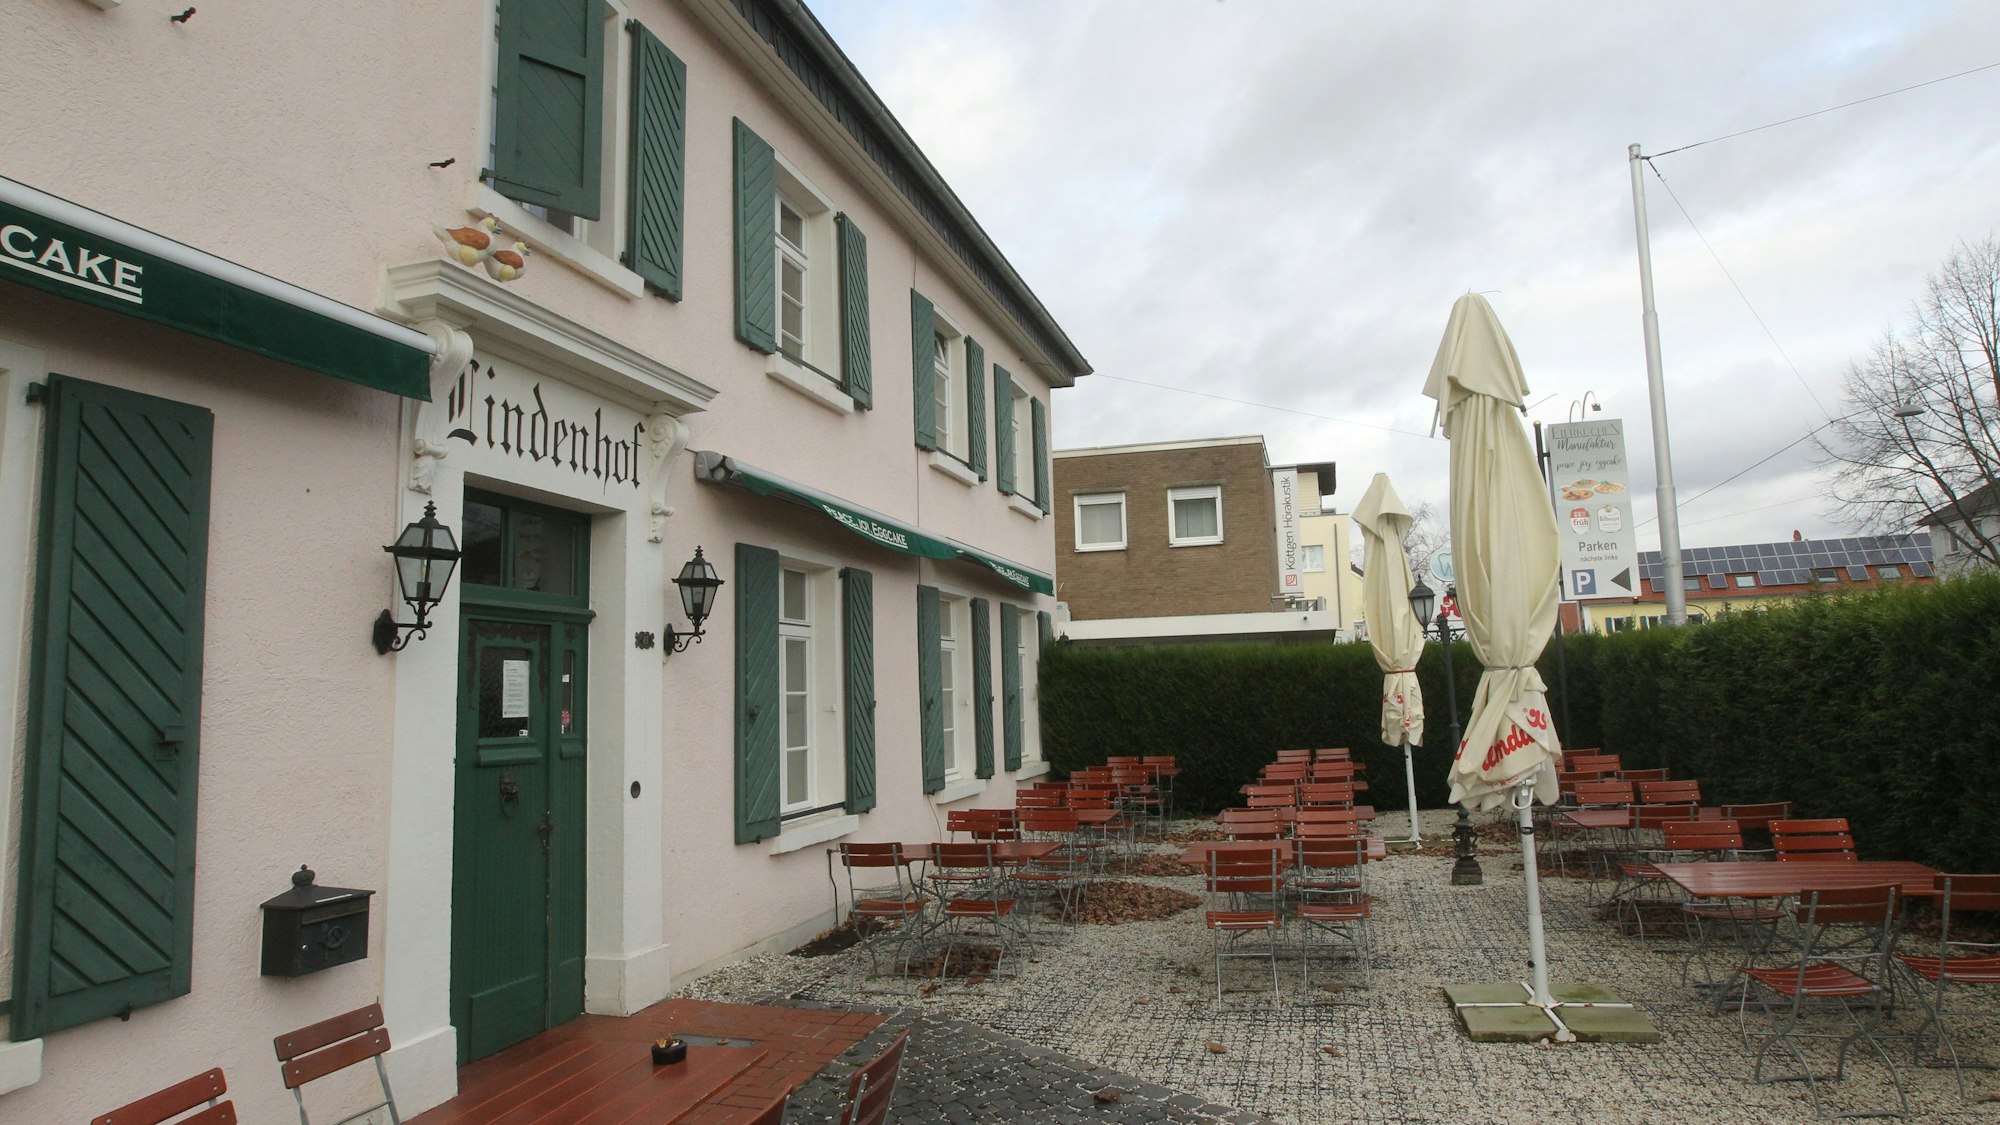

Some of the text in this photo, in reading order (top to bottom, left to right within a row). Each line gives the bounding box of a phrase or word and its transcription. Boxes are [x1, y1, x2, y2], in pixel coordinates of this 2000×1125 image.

[0, 224, 143, 296] CAKE
[447, 359, 645, 496] Lindenhof
[1557, 435, 1615, 451] Manufaktur
[1280, 476, 1297, 571] Köttgen Hörakustik
[1573, 518, 1588, 526] früh
[1578, 541, 1617, 552] Parken
[1576, 571, 1591, 593] P
